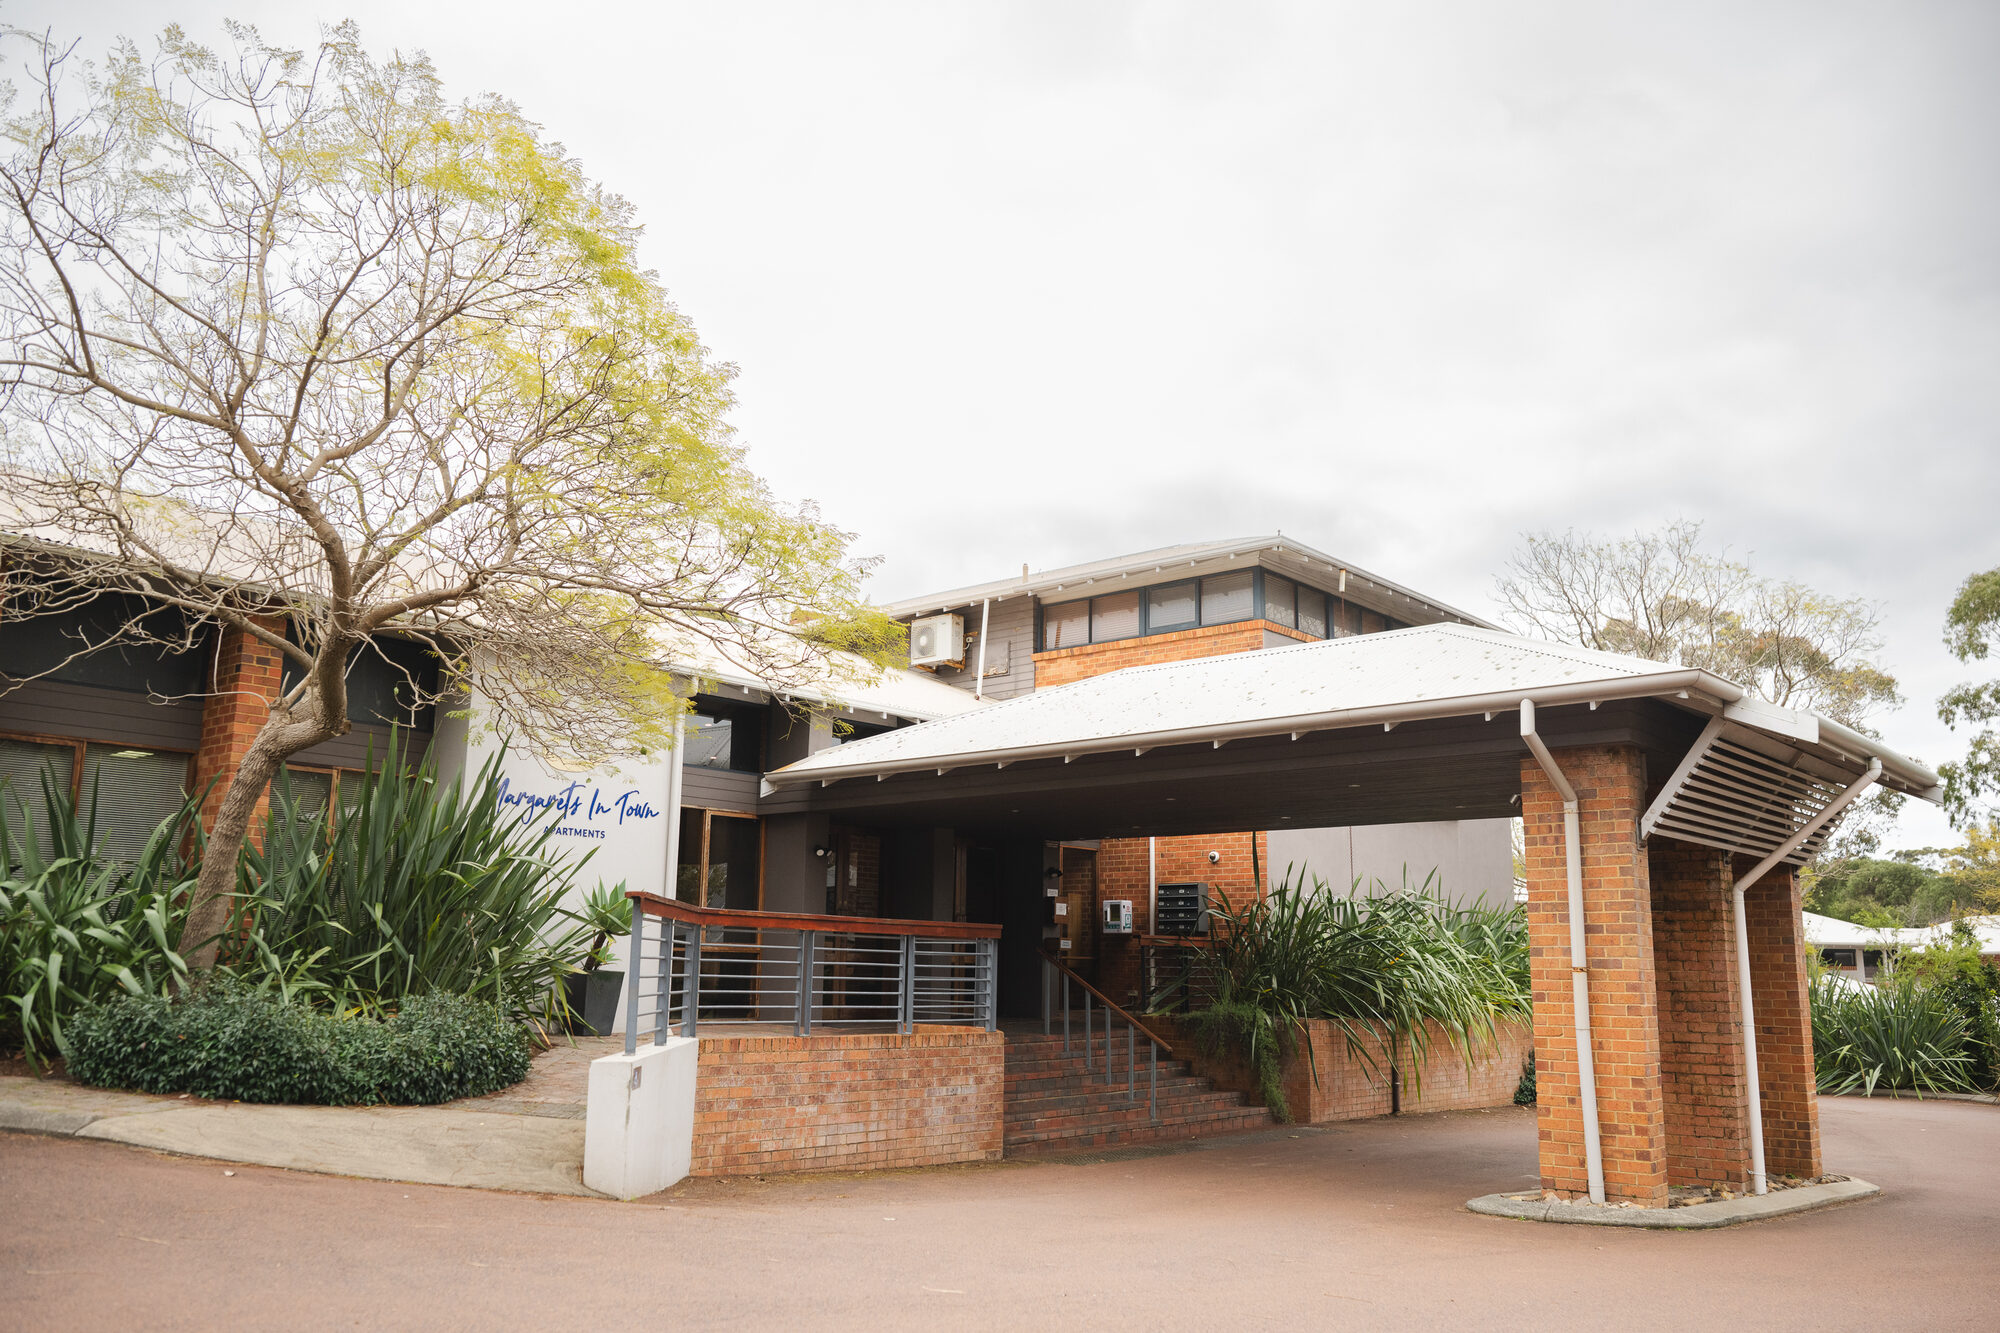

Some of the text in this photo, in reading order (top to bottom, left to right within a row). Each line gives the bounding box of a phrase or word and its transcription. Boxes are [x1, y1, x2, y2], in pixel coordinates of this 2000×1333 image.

[493, 777, 660, 825] Margarets In Town
